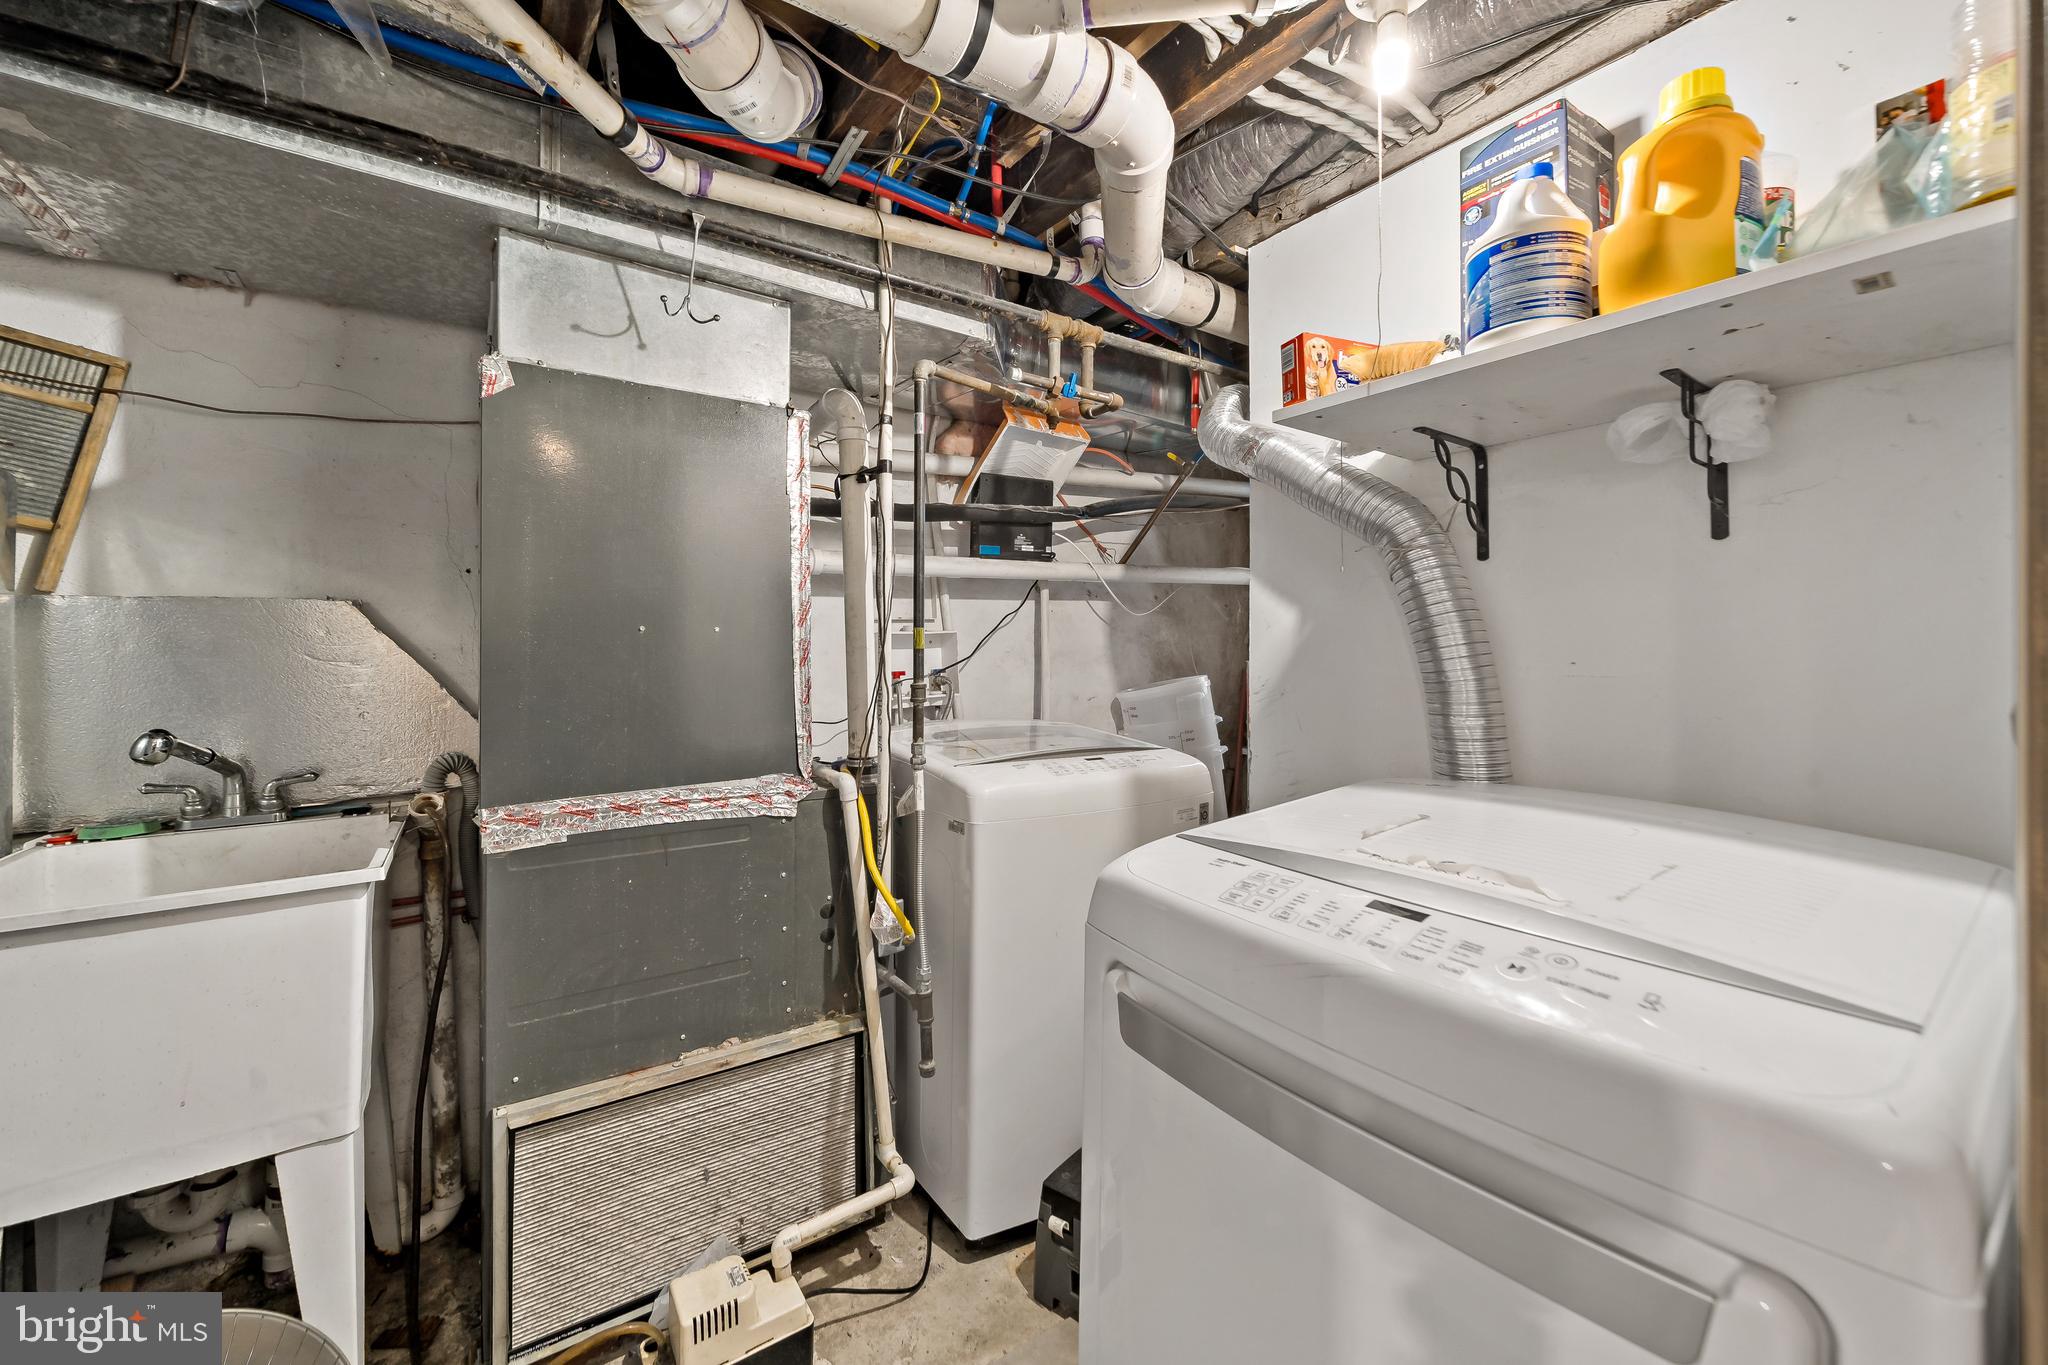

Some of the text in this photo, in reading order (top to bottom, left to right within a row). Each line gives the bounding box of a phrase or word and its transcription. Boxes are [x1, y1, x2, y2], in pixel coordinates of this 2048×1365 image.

[1461, 162, 1483, 179] FIRE
[1484, 126, 1560, 167] EXTINGUISHER
[1337, 379, 1346, 389] 3x
